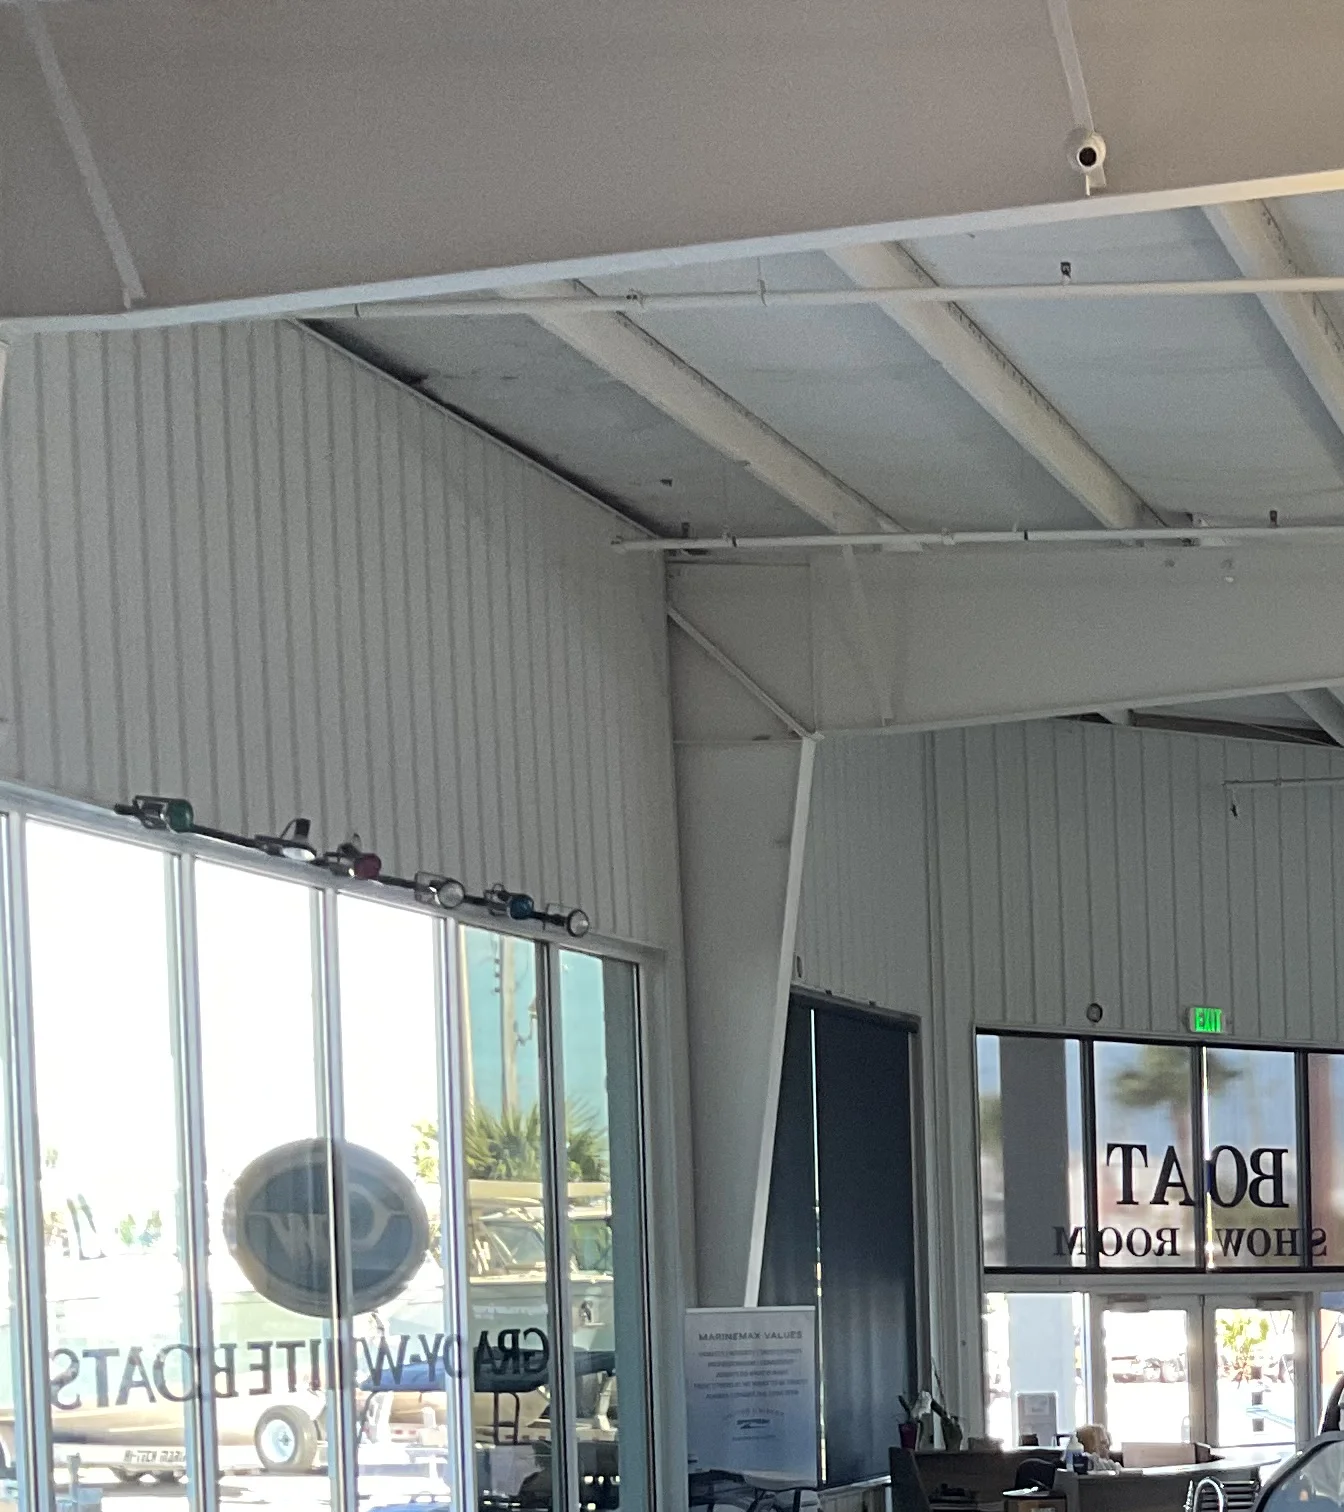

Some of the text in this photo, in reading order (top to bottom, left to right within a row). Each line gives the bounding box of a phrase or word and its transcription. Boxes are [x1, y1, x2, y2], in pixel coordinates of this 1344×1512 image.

[1195, 1007, 1223, 1033] EXIT
[698, 1330, 803, 1341] MARINEMAX VALUES
